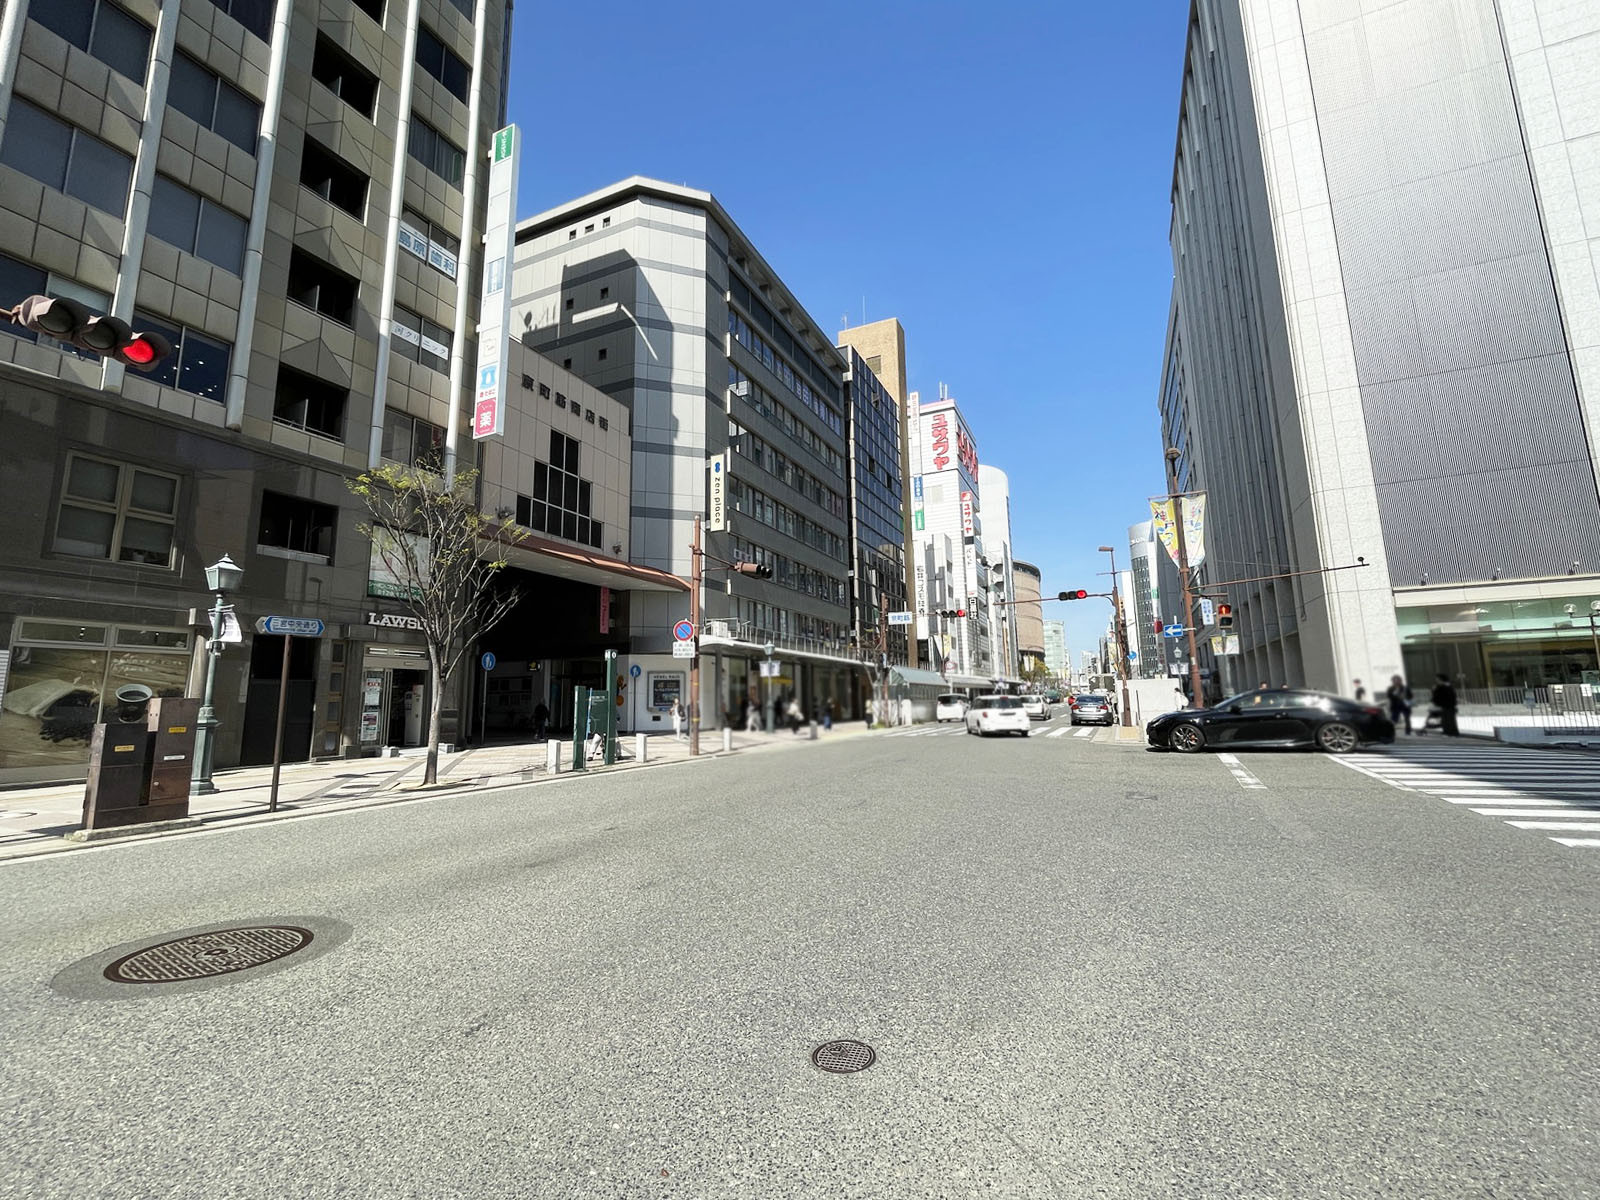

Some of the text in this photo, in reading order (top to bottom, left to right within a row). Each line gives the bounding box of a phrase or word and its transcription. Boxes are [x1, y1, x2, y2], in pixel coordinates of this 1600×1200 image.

[479, 411, 492, 429] 薬
[713, 497, 722, 524] place
[272, 618, 317, 630] 三宮中央通り
[368, 612, 435, 632] LAWS
